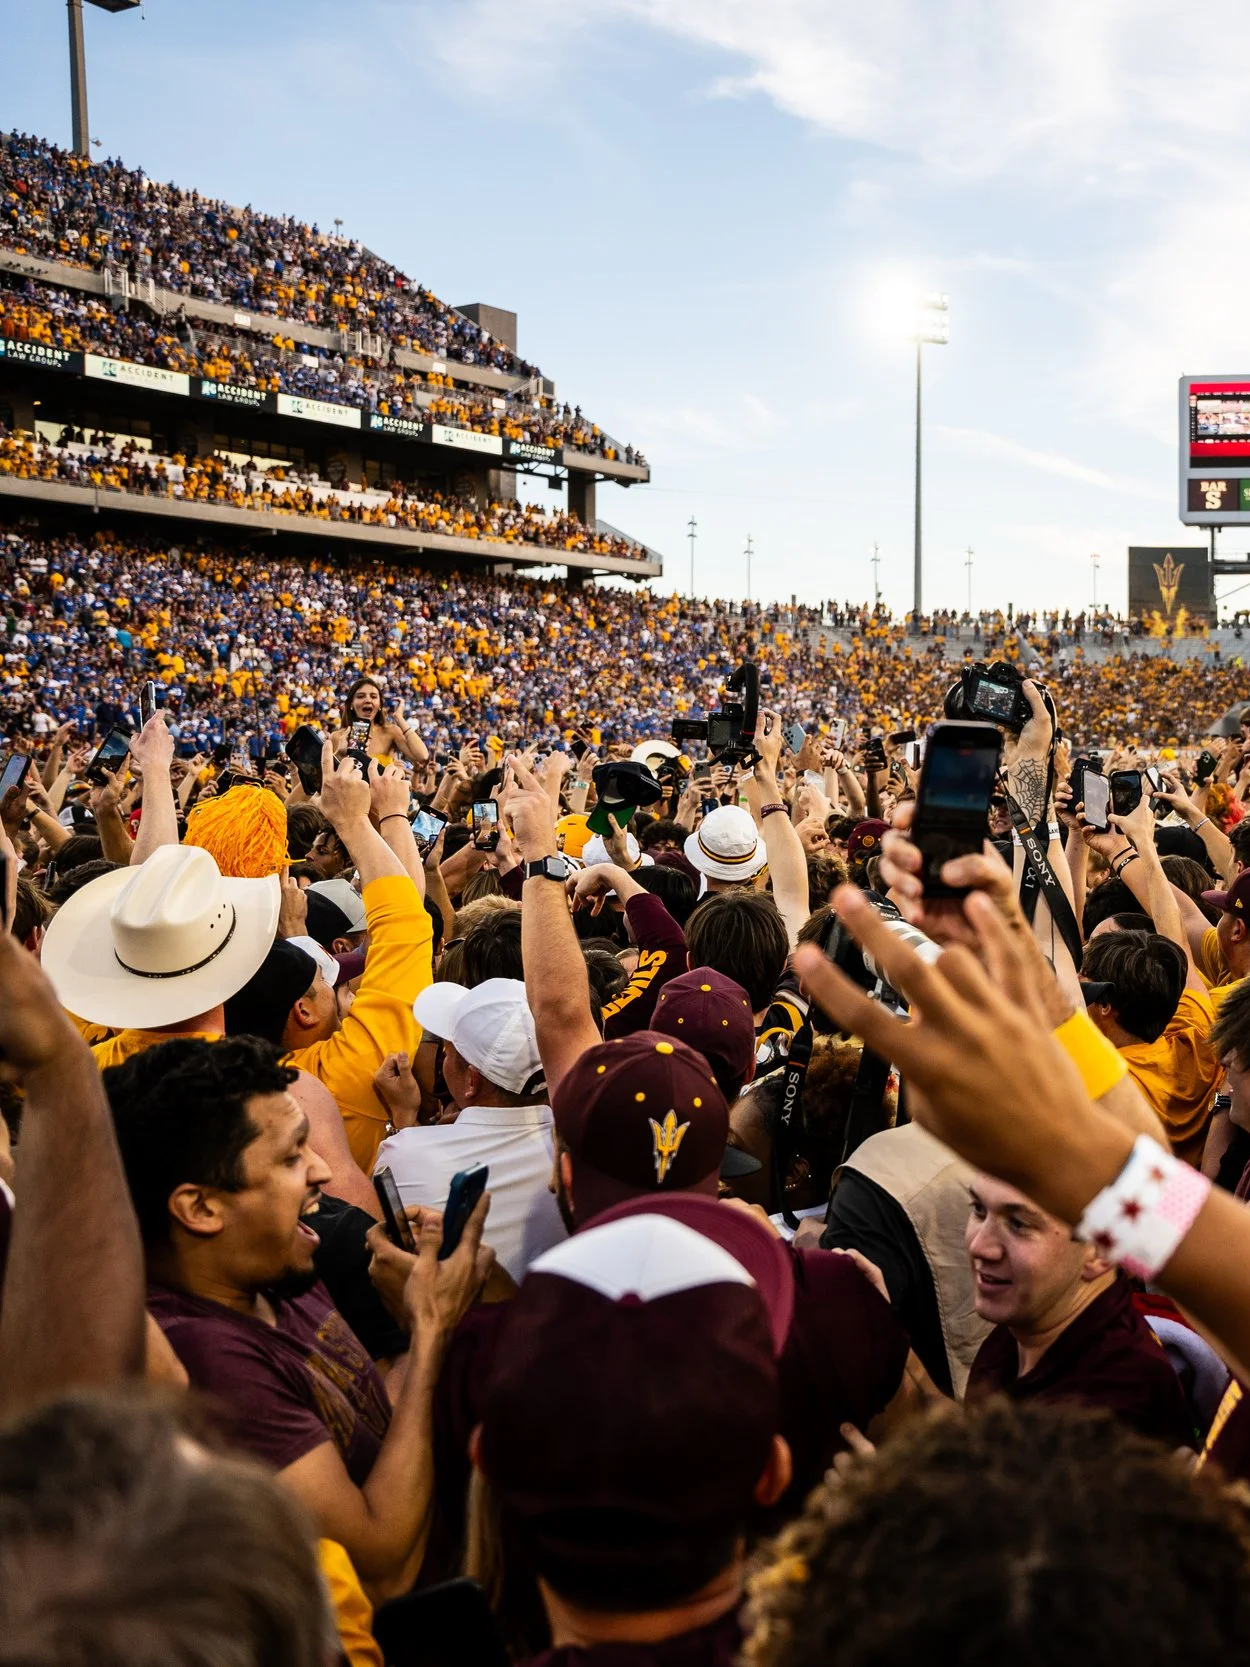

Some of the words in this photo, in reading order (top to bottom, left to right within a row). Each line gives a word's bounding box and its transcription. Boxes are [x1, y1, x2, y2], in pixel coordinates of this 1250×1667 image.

[7, 340, 70, 361] ACCIDENT
[8, 350, 26, 360] LAW
[29, 354, 58, 366] GROUP
[120, 365, 175, 381] ACCIDENT
[217, 383, 266, 401] ACCIDENT
[383, 417, 424, 431] ACCIDENT
[1200, 481, 1226, 492] BAR
[1205, 491, 1221, 509] S
[1026, 838, 1056, 887] SONY
[600, 949, 668, 1021] DEVILS
[780, 1071, 800, 1127] SONY
